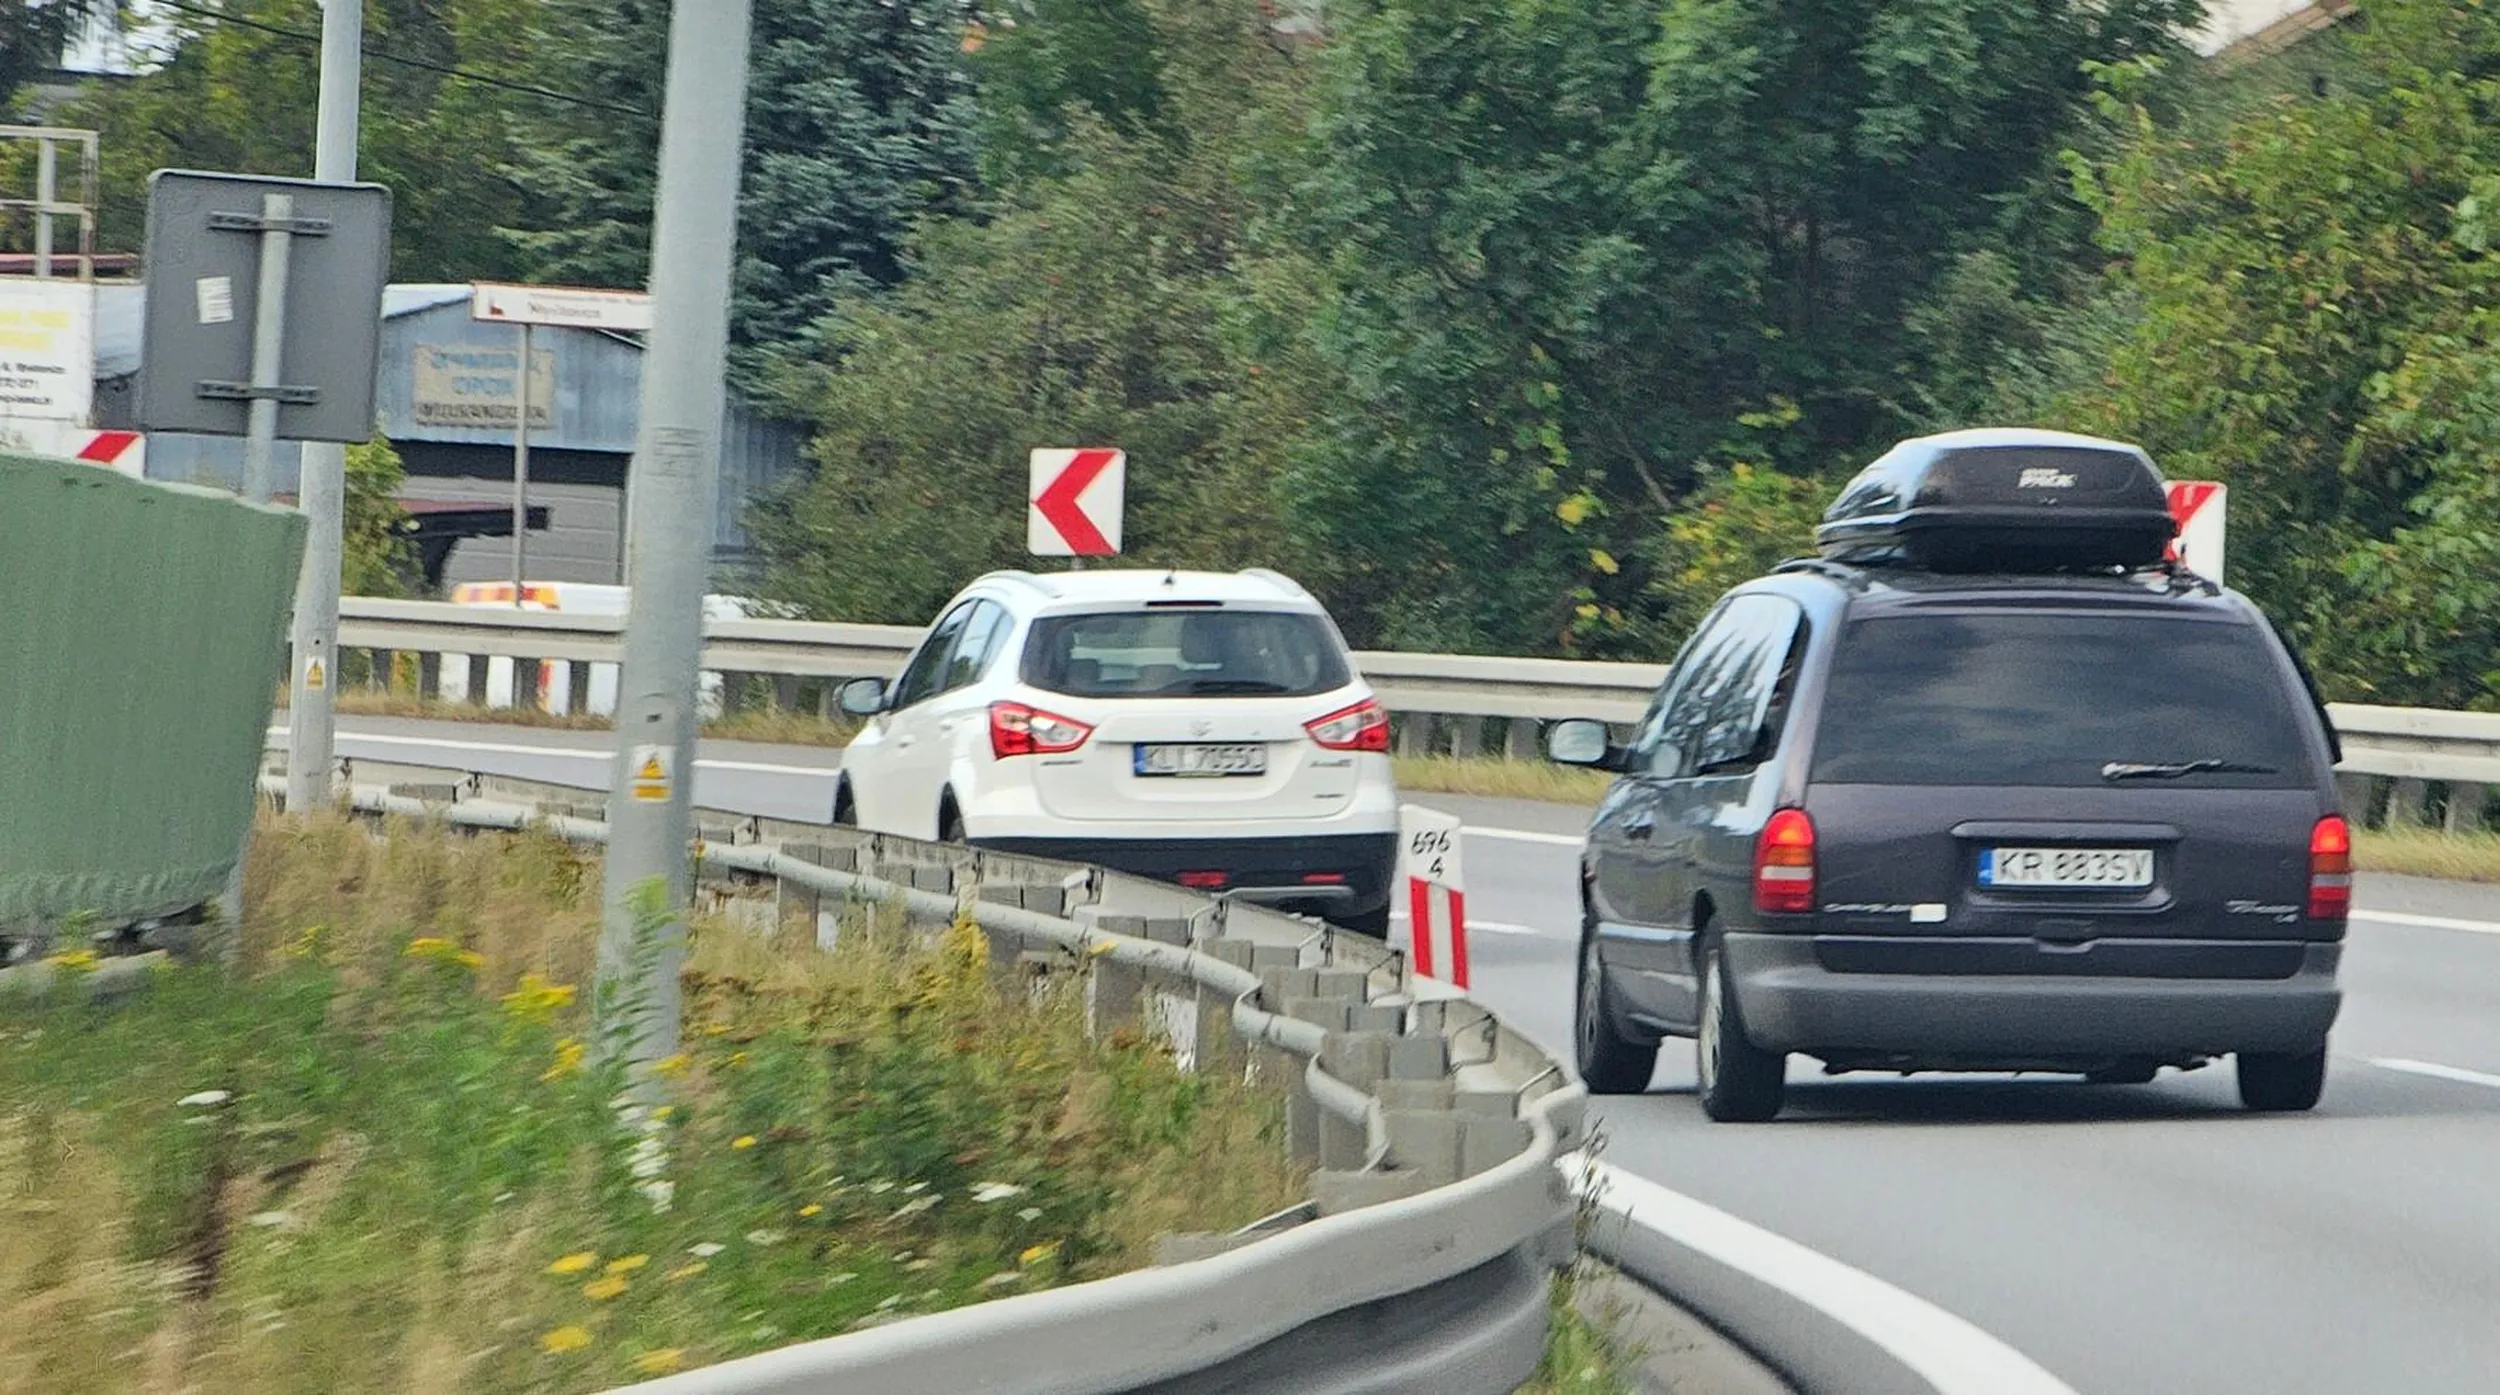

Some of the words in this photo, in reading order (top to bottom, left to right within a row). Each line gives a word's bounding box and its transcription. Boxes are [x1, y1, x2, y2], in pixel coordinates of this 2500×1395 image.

[1411, 829, 1451, 856] 696
[1429, 856, 1445, 878] 4
[1999, 852, 2043, 881] KR
